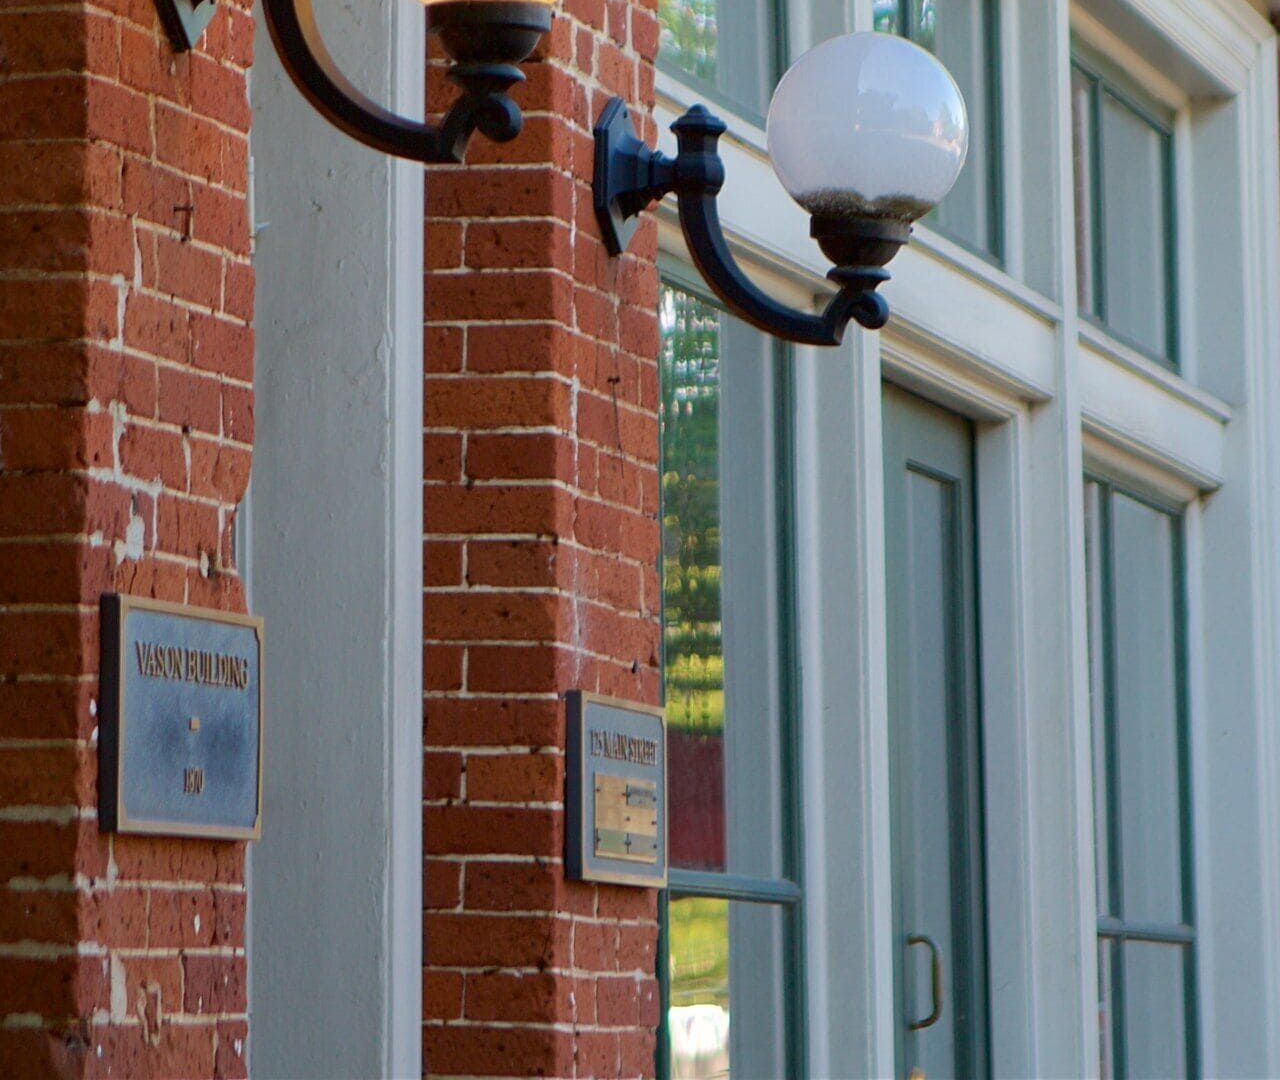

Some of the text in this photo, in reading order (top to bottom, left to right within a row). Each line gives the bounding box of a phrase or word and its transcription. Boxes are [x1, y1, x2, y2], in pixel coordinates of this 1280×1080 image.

[135, 640, 249, 691] VASON BUILDING
[603, 731, 626, 761] MAIN
[628, 736, 658, 767] STREET
